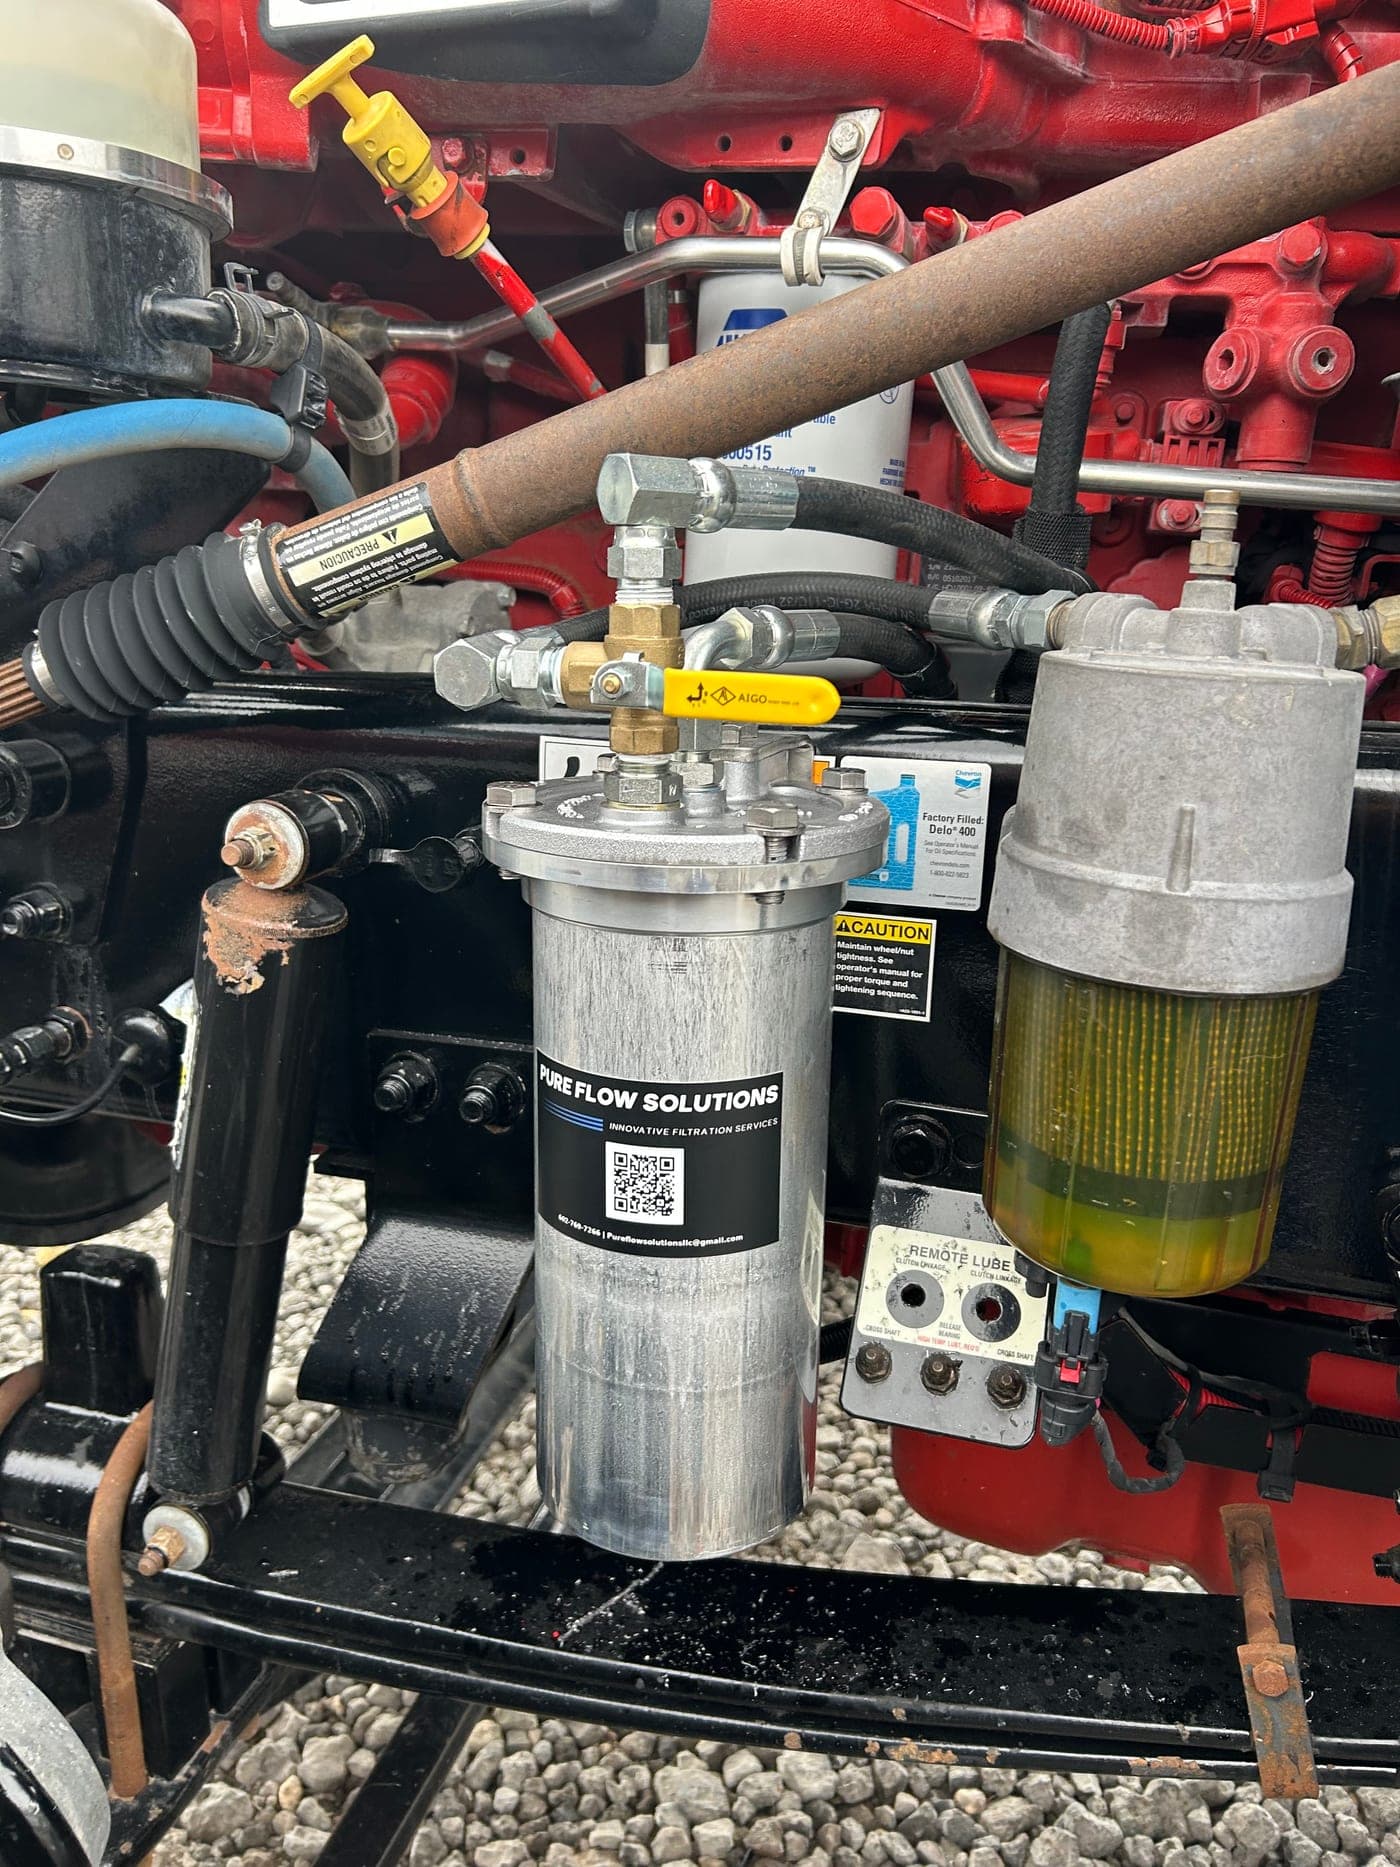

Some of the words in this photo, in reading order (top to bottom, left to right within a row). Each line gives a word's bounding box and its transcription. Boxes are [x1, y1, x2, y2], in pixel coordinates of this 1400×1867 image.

[723, 444, 772, 461] 00515
[318, 538, 379, 570] PRECAUCION
[738, 693, 767, 704] AIGO
[923, 813, 954, 824] Factory
[957, 815, 984, 824] Filled:
[959, 827, 976, 836] 400
[852, 921, 929, 940] CAUTION
[837, 941, 872, 951] Maintain
[874, 945, 914, 956] wheel/nut
[837, 952, 876, 962] tightness.
[878, 956, 894, 964] See
[836, 963, 877, 973] operator's
[879, 968, 909, 976] manual
[835, 974, 863, 982] proper
[864, 977, 890, 985] torque
[835, 984, 875, 995] tightening
[876, 990, 918, 999] sequence.
[539, 1063, 573, 1096] PURE
[574, 1082, 639, 1110] FLOW
[642, 1084, 779, 1113] SOLUTIONS
[609, 1122, 670, 1136] INNOVATIVE
[672, 1125, 733, 1137] FILTRATION
[735, 1117, 778, 1132] SERVICES
[909, 1245, 968, 1265] REMOTE
[972, 1255, 1011, 1272] LUBE
[970, 1270, 994, 1280] CLUTCH
[995, 1273, 1022, 1284] LINKAGE
[884, 1327, 901, 1336] SHAFT
[997, 1348, 1016, 1358] CROSS
[1017, 1351, 1034, 1361] SHAFT
